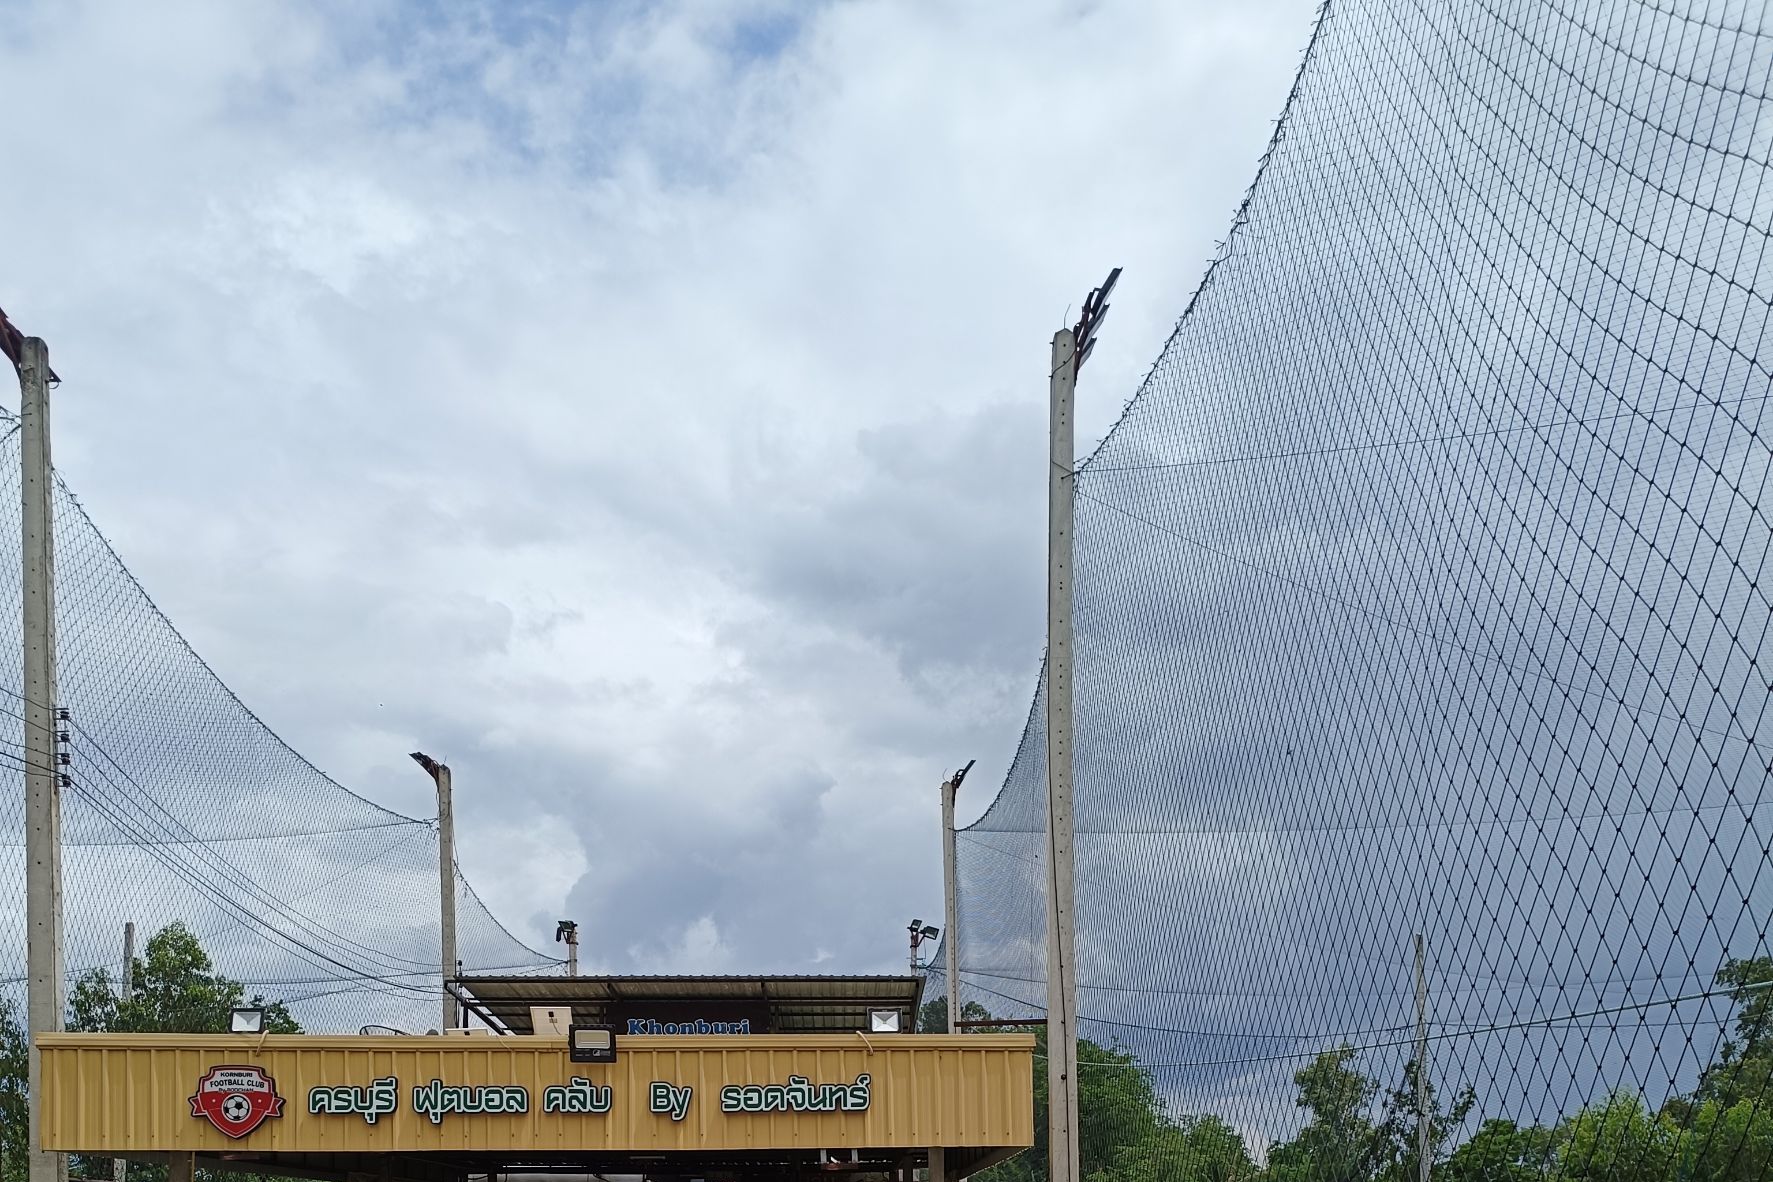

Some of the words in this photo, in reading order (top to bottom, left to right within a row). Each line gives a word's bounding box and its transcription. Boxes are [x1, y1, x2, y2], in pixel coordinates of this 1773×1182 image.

[627, 1018, 751, 1035] Khonburi
[209, 1079, 245, 1088] FOOTBALL
[246, 1079, 265, 1089] CLUB
[309, 1077, 397, 1123] ครบุรี
[413, 1079, 528, 1123] ฟุตบอล
[544, 1077, 612, 1113] คลับ
[650, 1082, 692, 1120] By
[721, 1074, 871, 1112] รอดจันทร์
